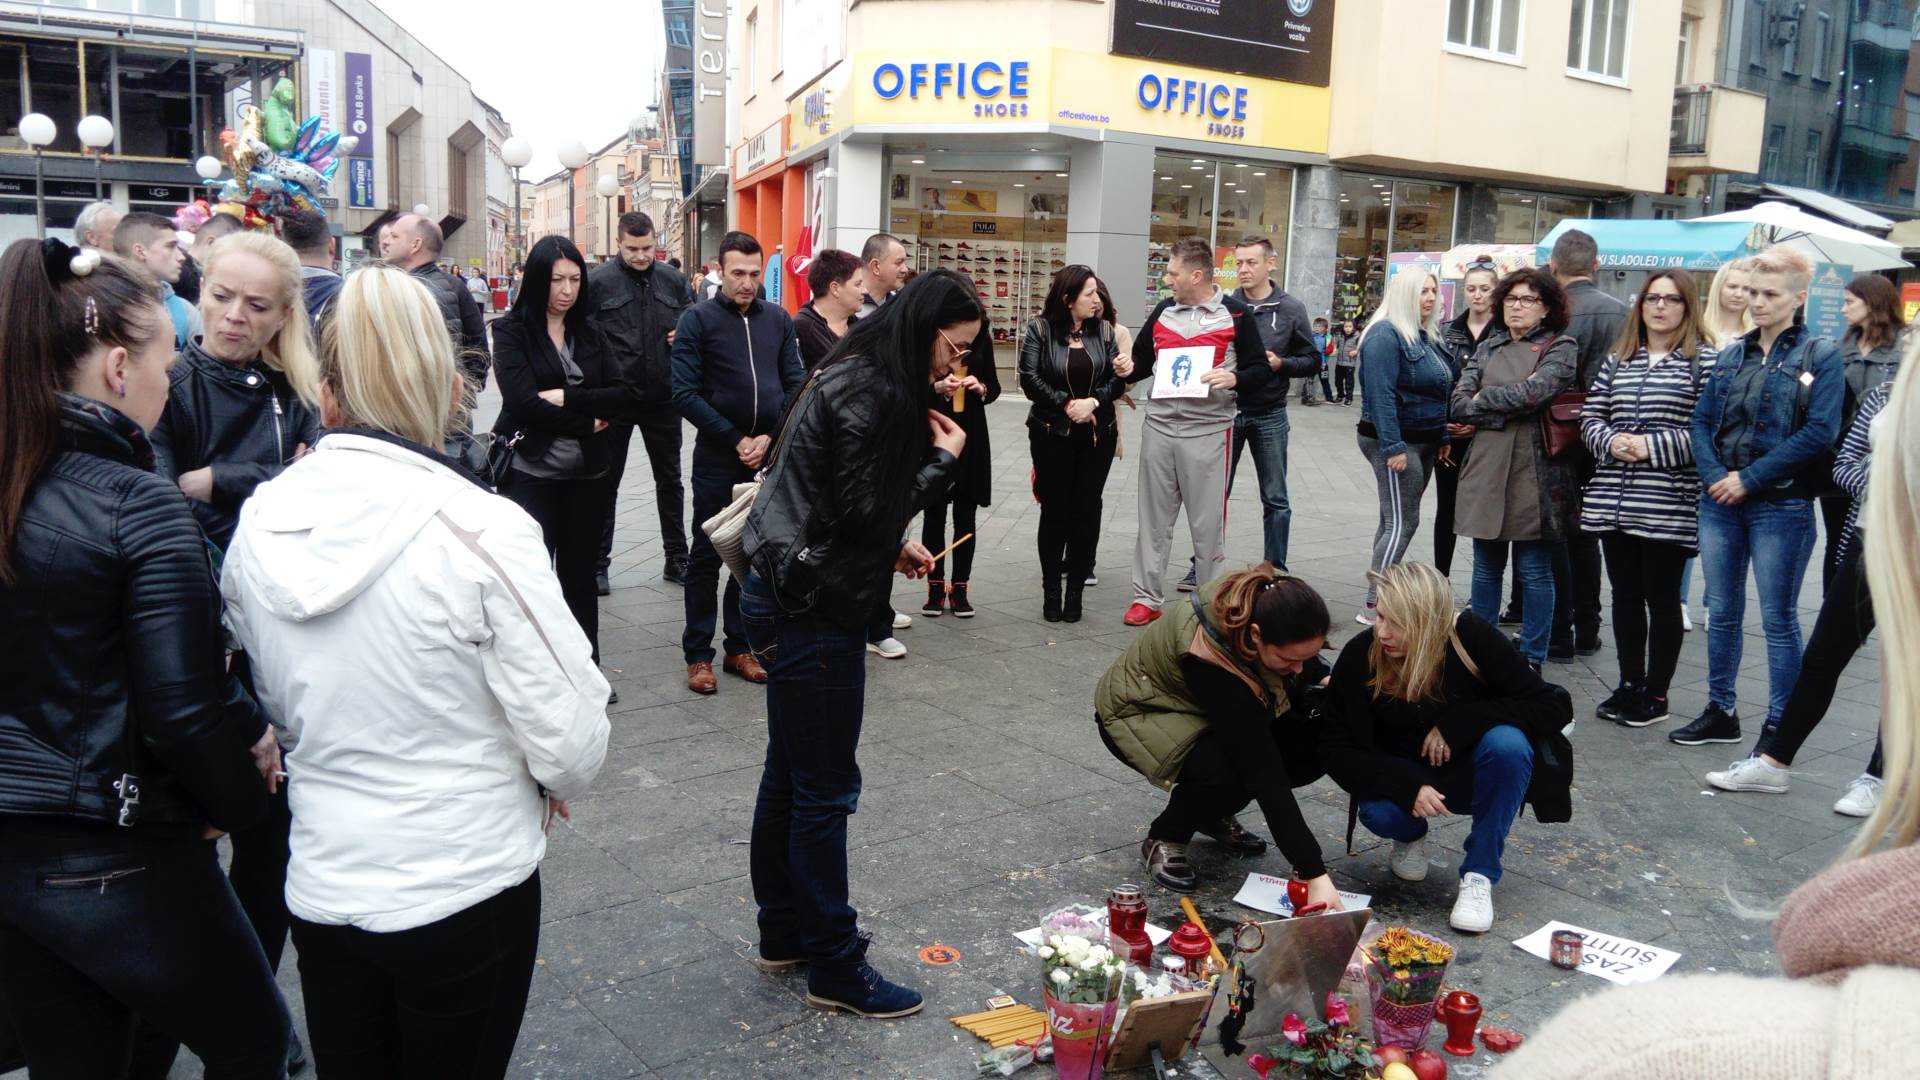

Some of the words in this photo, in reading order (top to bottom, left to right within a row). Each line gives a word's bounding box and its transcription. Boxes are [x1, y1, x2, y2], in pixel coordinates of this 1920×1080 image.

[1167, 1, 1220, 15] HERCEGOVINA
[1284, 20, 1311, 32] Privredna
[354, 75, 364, 100] Banka
[873, 61, 1029, 100] OFFICE
[1138, 73, 1249, 121] OFFICE
[354, 100, 364, 118] NLB
[974, 103, 1029, 117] SHOES
[1058, 110, 1110, 123] officeshoes.ba
[1207, 123, 1245, 138] SHOES
[149, 188, 169, 197] UGG
[975, 223, 995, 231] POLO
[1608, 254, 1658, 267] SLADOLED
[1661, 256, 1666, 266] 1
[1668, 256, 1684, 267] KM
[1581, 952, 1634, 975] ZAŠ
